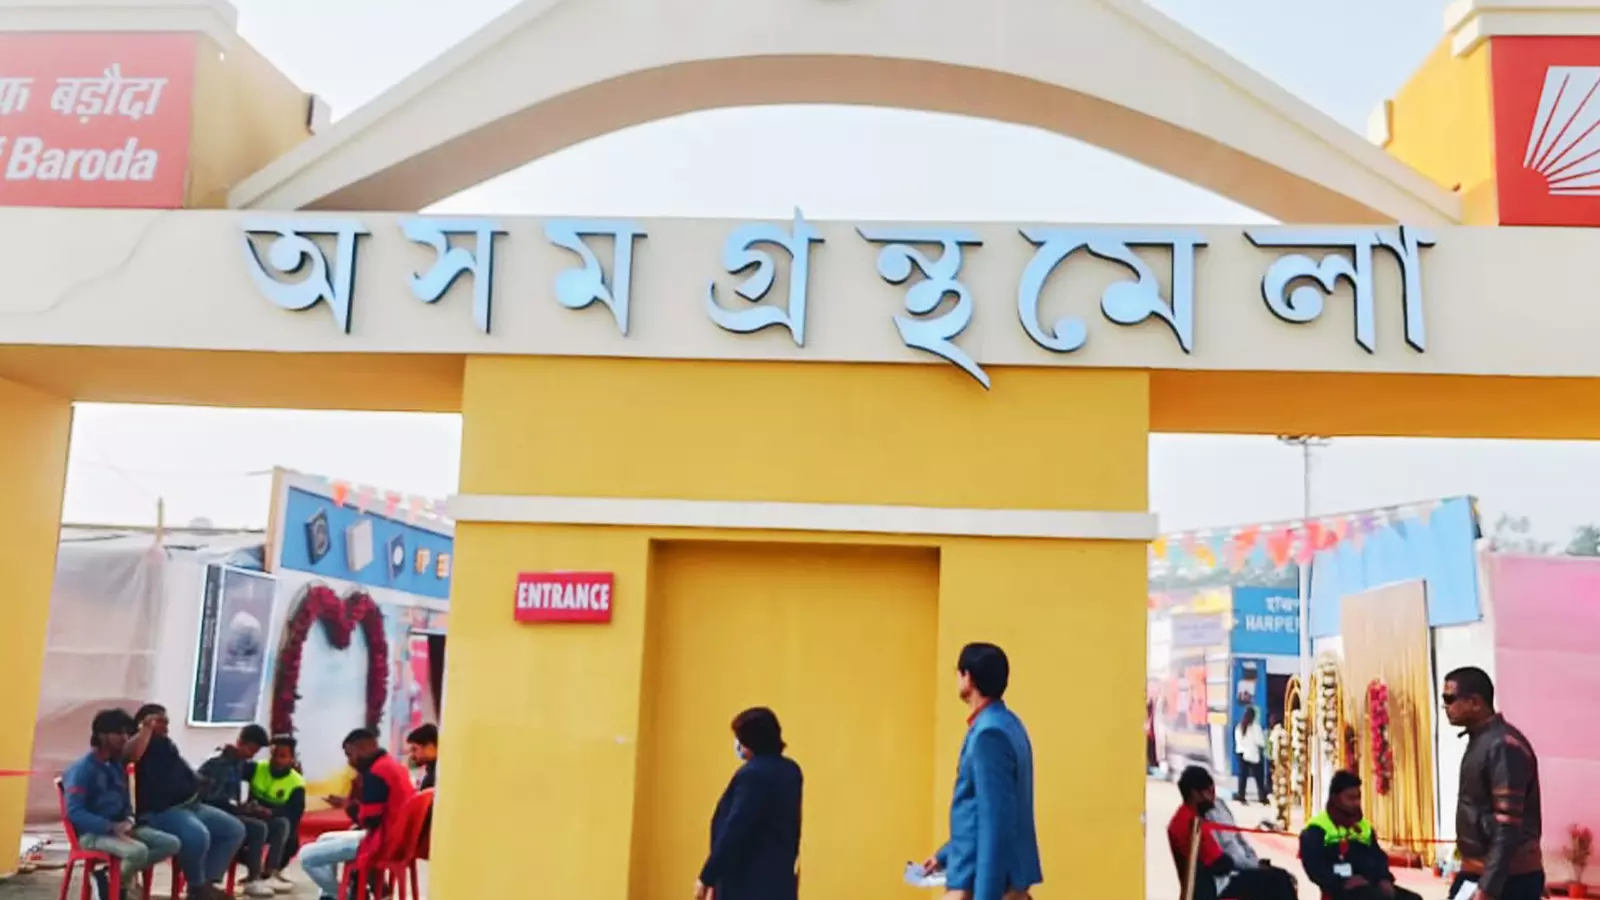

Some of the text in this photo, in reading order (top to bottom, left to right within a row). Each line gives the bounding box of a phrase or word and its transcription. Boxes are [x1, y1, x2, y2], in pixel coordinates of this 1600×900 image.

[51, 63, 168, 124] बड़ौदा
[5, 136, 158, 181] Baroda
[241, 214, 648, 335] অসম
[517, 582, 610, 610] ENTRANCE
